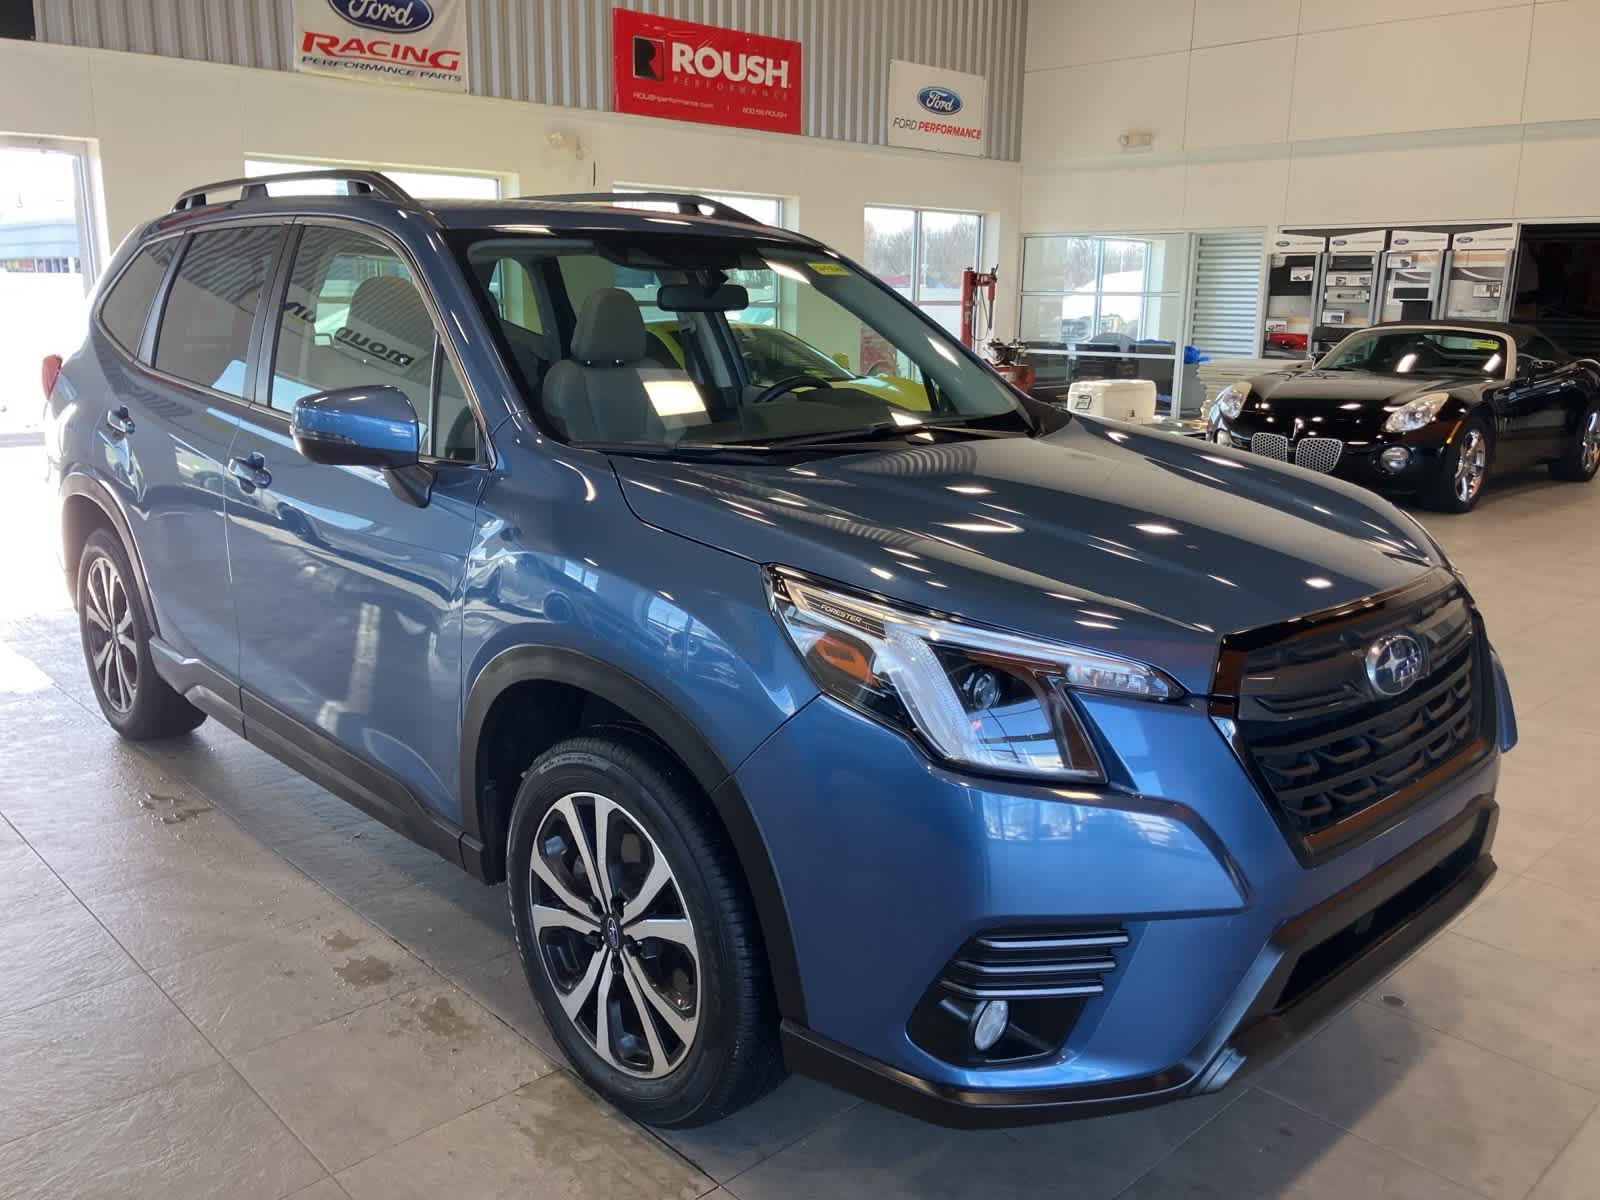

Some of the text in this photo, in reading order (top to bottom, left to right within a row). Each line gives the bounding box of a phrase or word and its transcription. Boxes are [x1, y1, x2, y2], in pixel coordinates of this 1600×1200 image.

[348, 0, 414, 26] Ford
[302, 31, 461, 71] RACING
[302, 56, 462, 82] PERFORMANCE PARTS
[671, 42, 788, 89] ROUSH
[673, 75, 788, 101] PERFORMANCE
[926, 90, 954, 111] Ford
[893, 117, 982, 139] FORD PERFORMANCE
[819, 603, 862, 623] FORESTER
